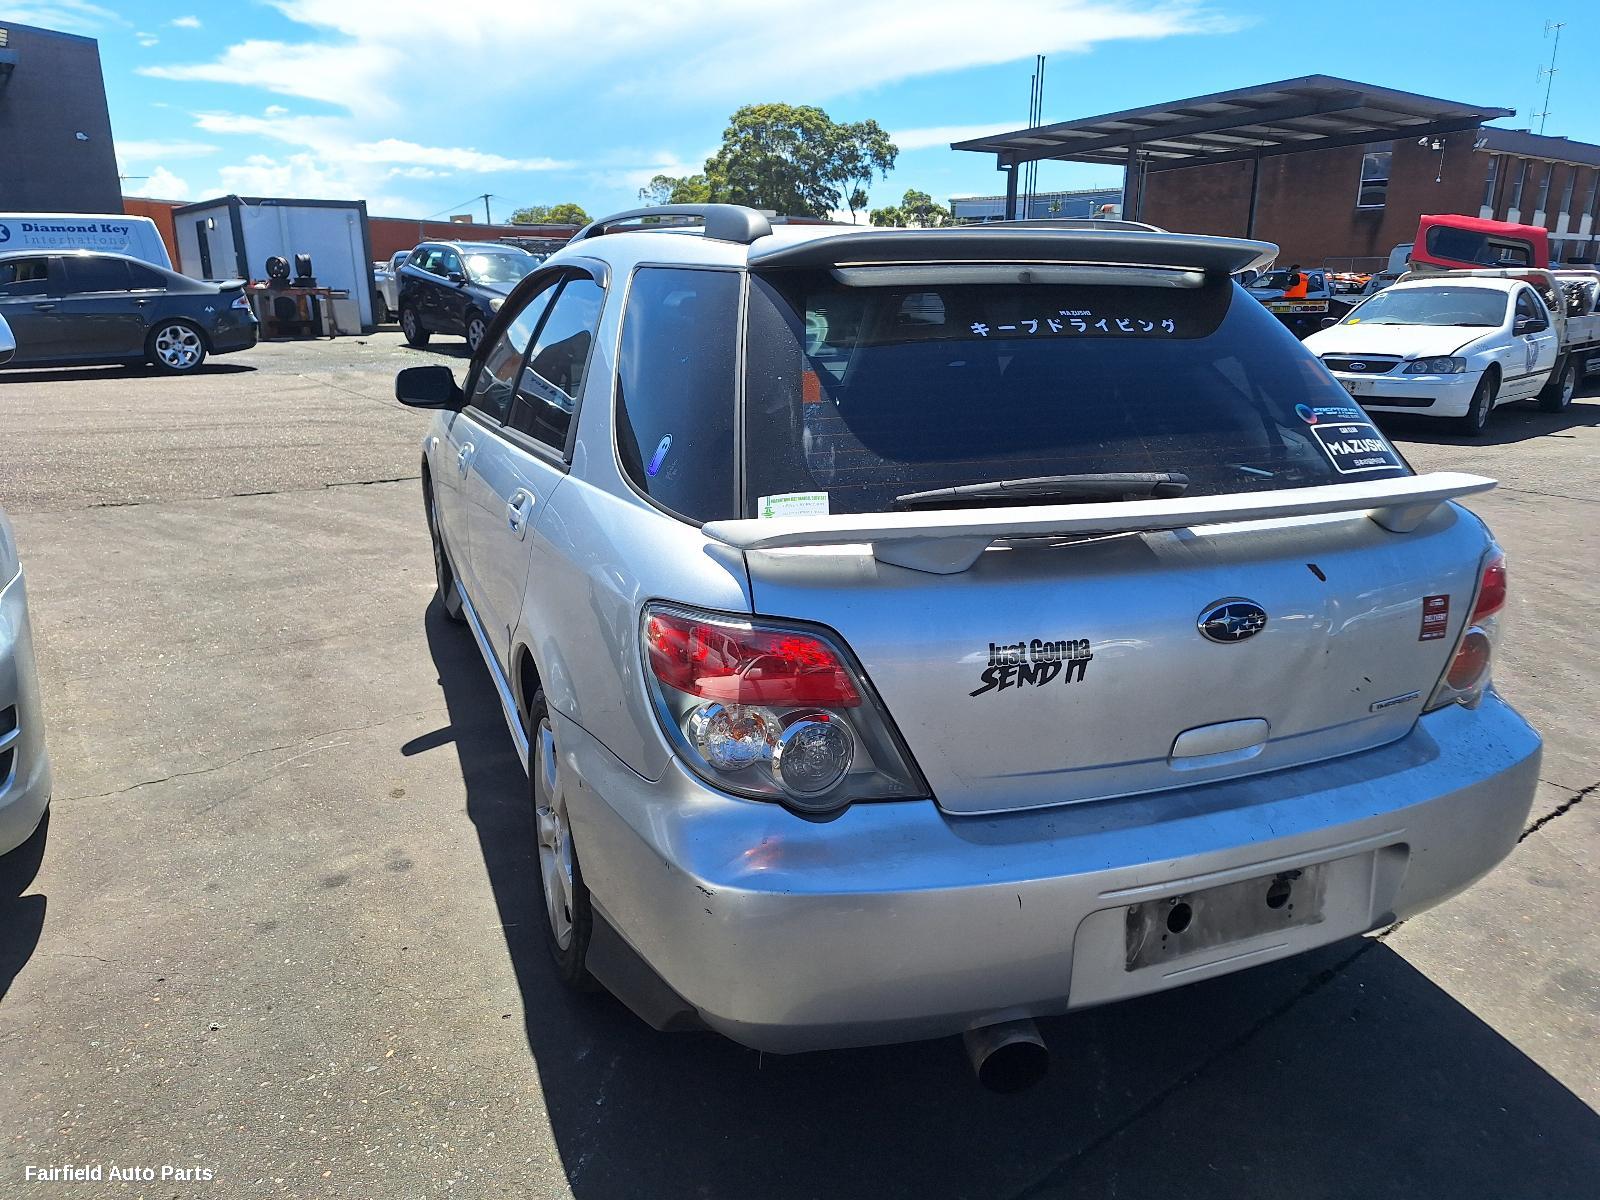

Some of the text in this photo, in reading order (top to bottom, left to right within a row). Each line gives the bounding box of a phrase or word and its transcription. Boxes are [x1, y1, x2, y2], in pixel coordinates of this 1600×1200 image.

[21, 223, 129, 236] Diamond Key
[1326, 439, 1388, 455] MAZUSHI
[987, 638, 1092, 667] Just Gonna
[968, 653, 1093, 697] SEND IT
